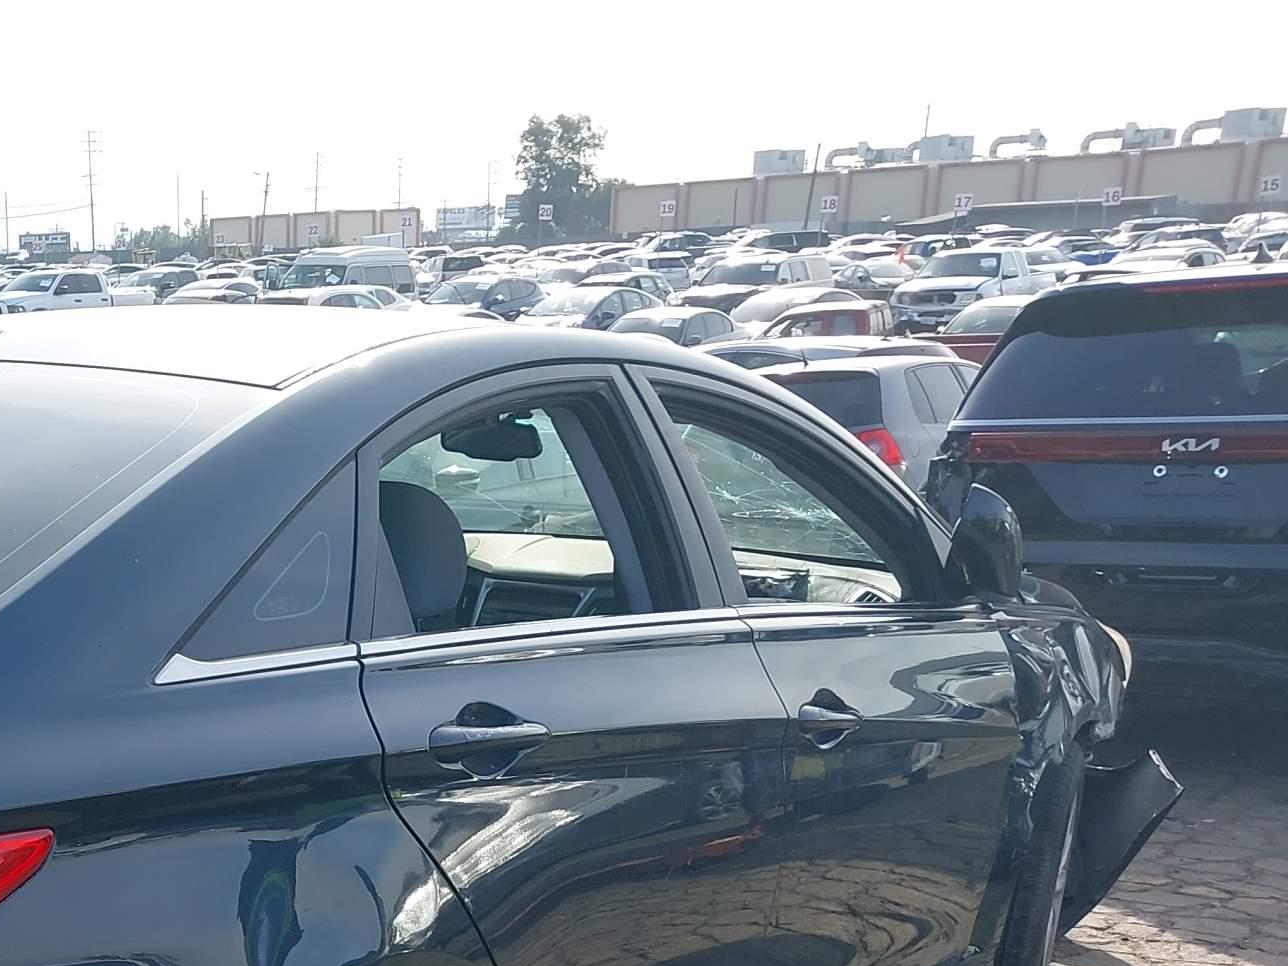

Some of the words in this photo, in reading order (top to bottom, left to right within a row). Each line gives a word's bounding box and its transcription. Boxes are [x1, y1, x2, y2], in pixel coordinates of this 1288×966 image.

[1262, 178, 1280, 192] 15
[955, 195, 972, 208] 17
[1104, 190, 1121, 203] 16
[661, 203, 674, 214] 19
[822, 199, 837, 210] 18
[539, 207, 552, 218] 20
[401, 217, 413, 227] 21
[307, 225, 319, 235] 22
[215, 234, 225, 244] 23
